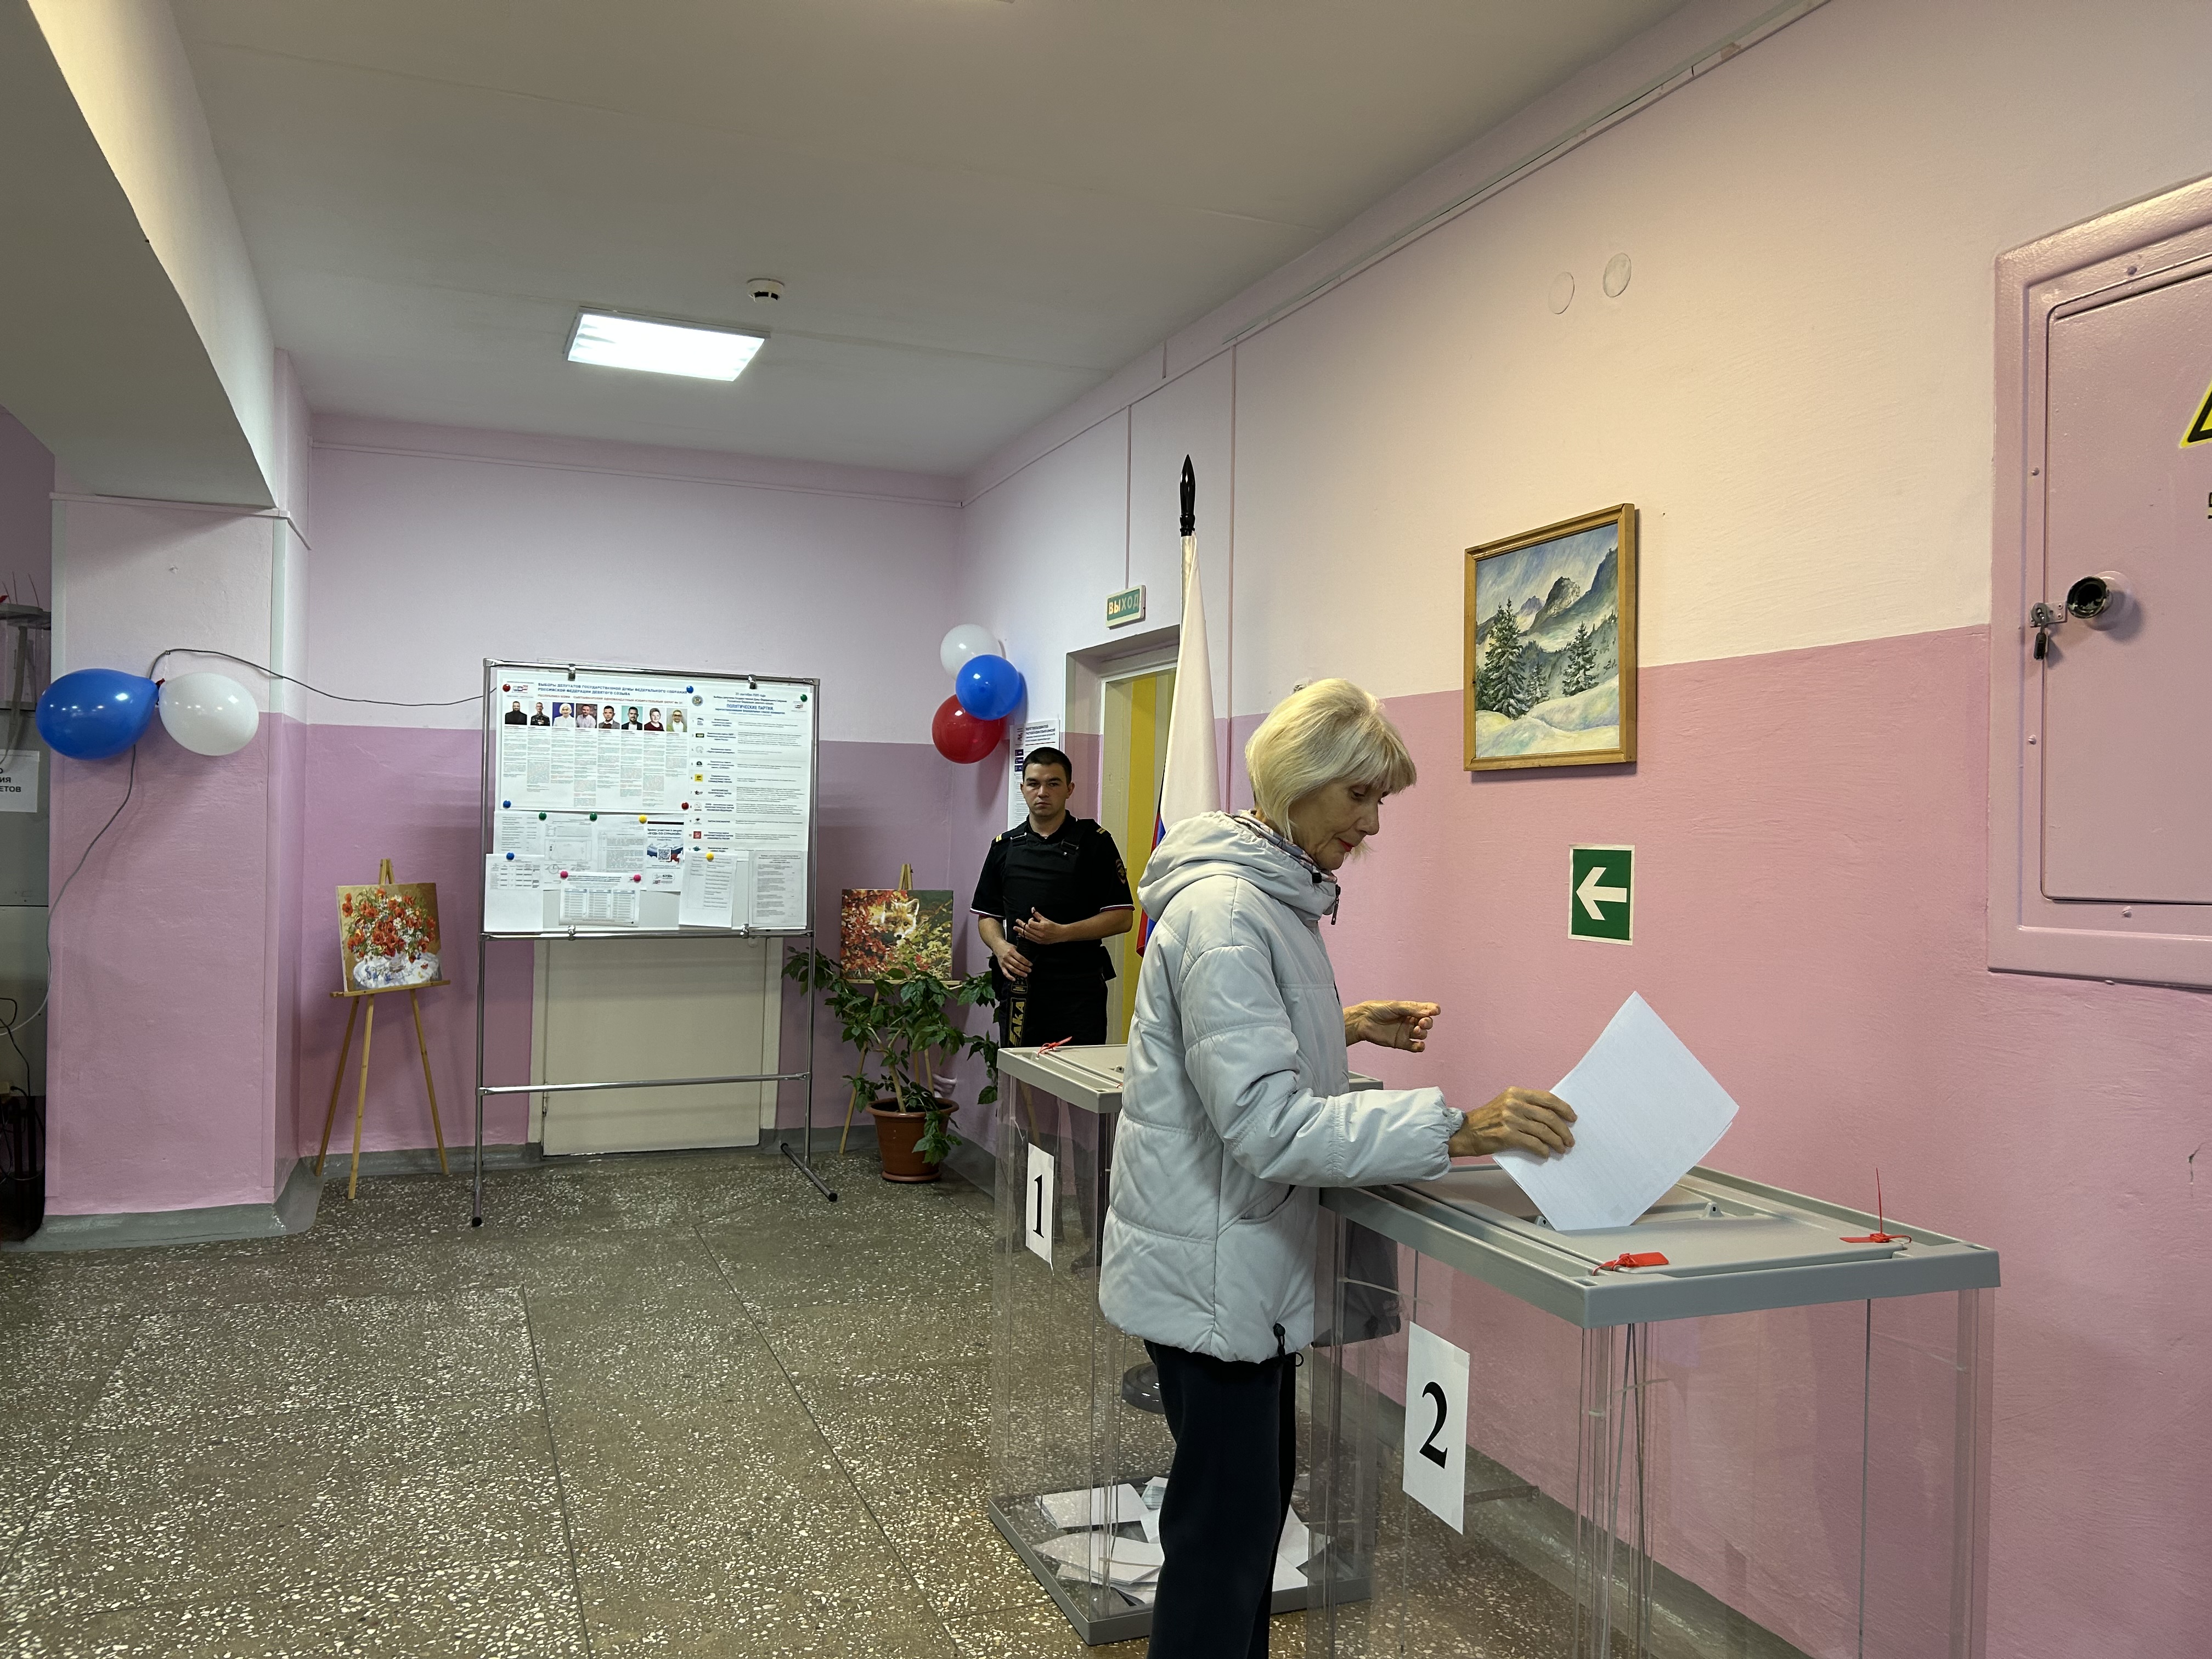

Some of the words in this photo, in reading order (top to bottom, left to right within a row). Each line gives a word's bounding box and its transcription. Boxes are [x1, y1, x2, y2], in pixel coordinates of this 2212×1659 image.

[1109, 594, 1139, 614] ВЫХОД
[1033, 1174, 1045, 1239] 1
[1419, 1381, 1448, 1469] 2
